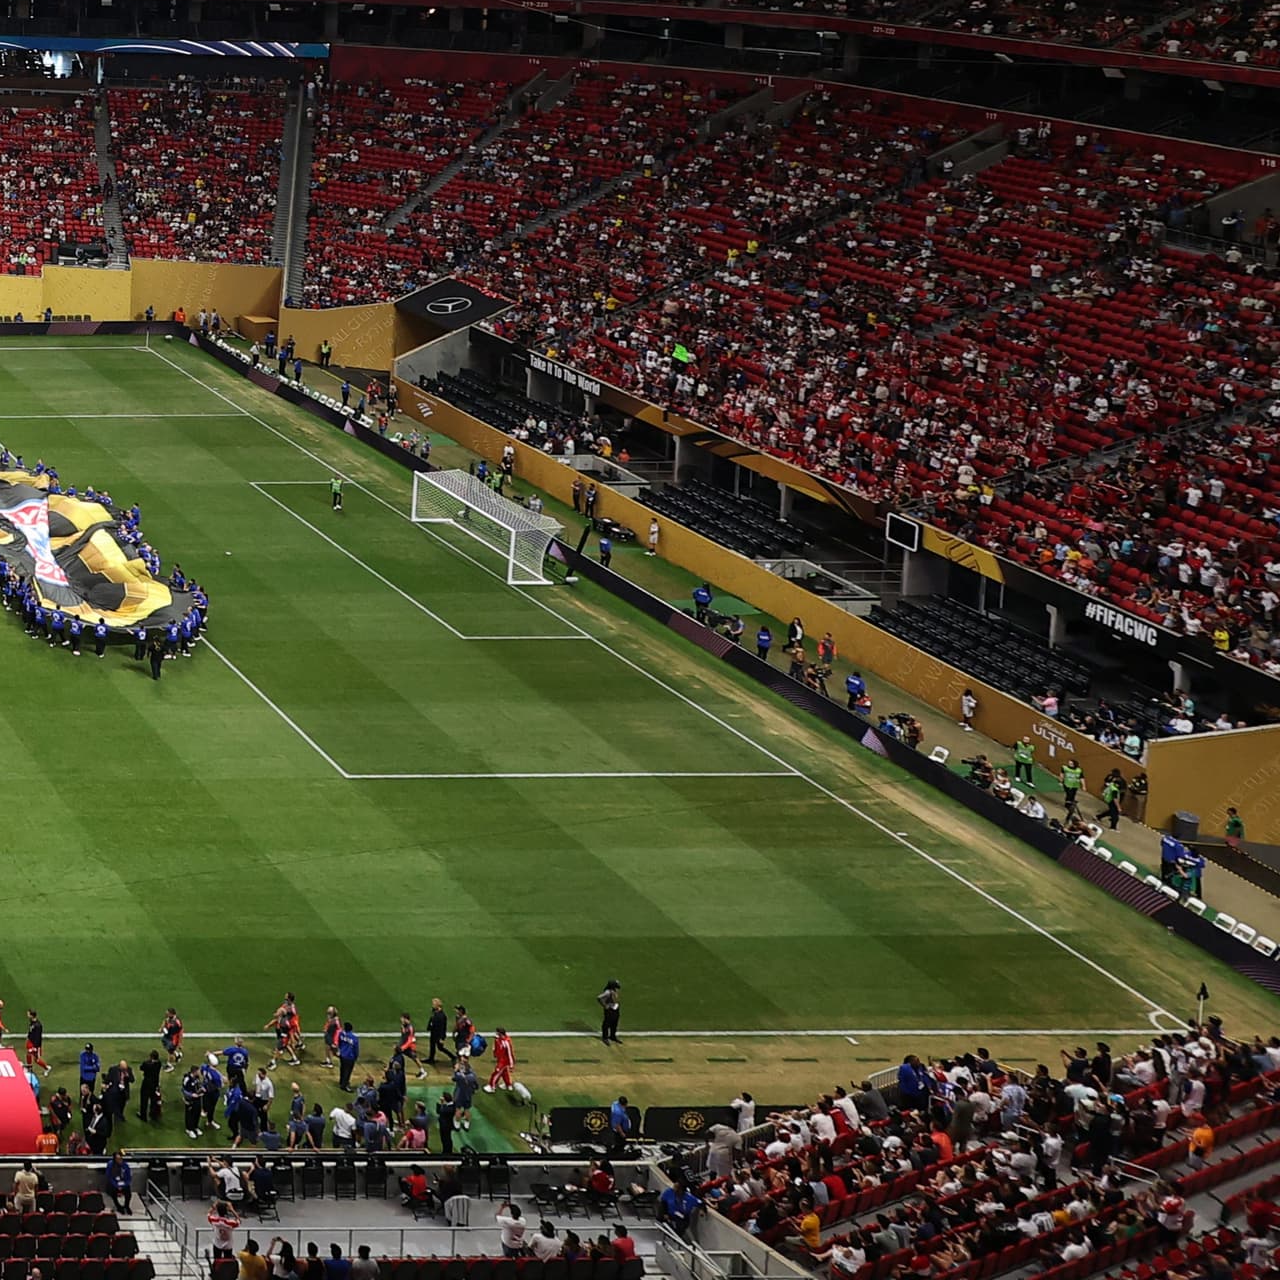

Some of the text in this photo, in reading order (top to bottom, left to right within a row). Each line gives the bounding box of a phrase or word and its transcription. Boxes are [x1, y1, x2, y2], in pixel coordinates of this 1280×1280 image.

[530, 354, 546, 372] Take
[554, 364, 562, 379] To
[563, 368, 576, 385] The
[577, 374, 600, 396] World
[1085, 602, 1158, 646] #FIFACWC
[1032, 723, 1075, 753] ULTRA
